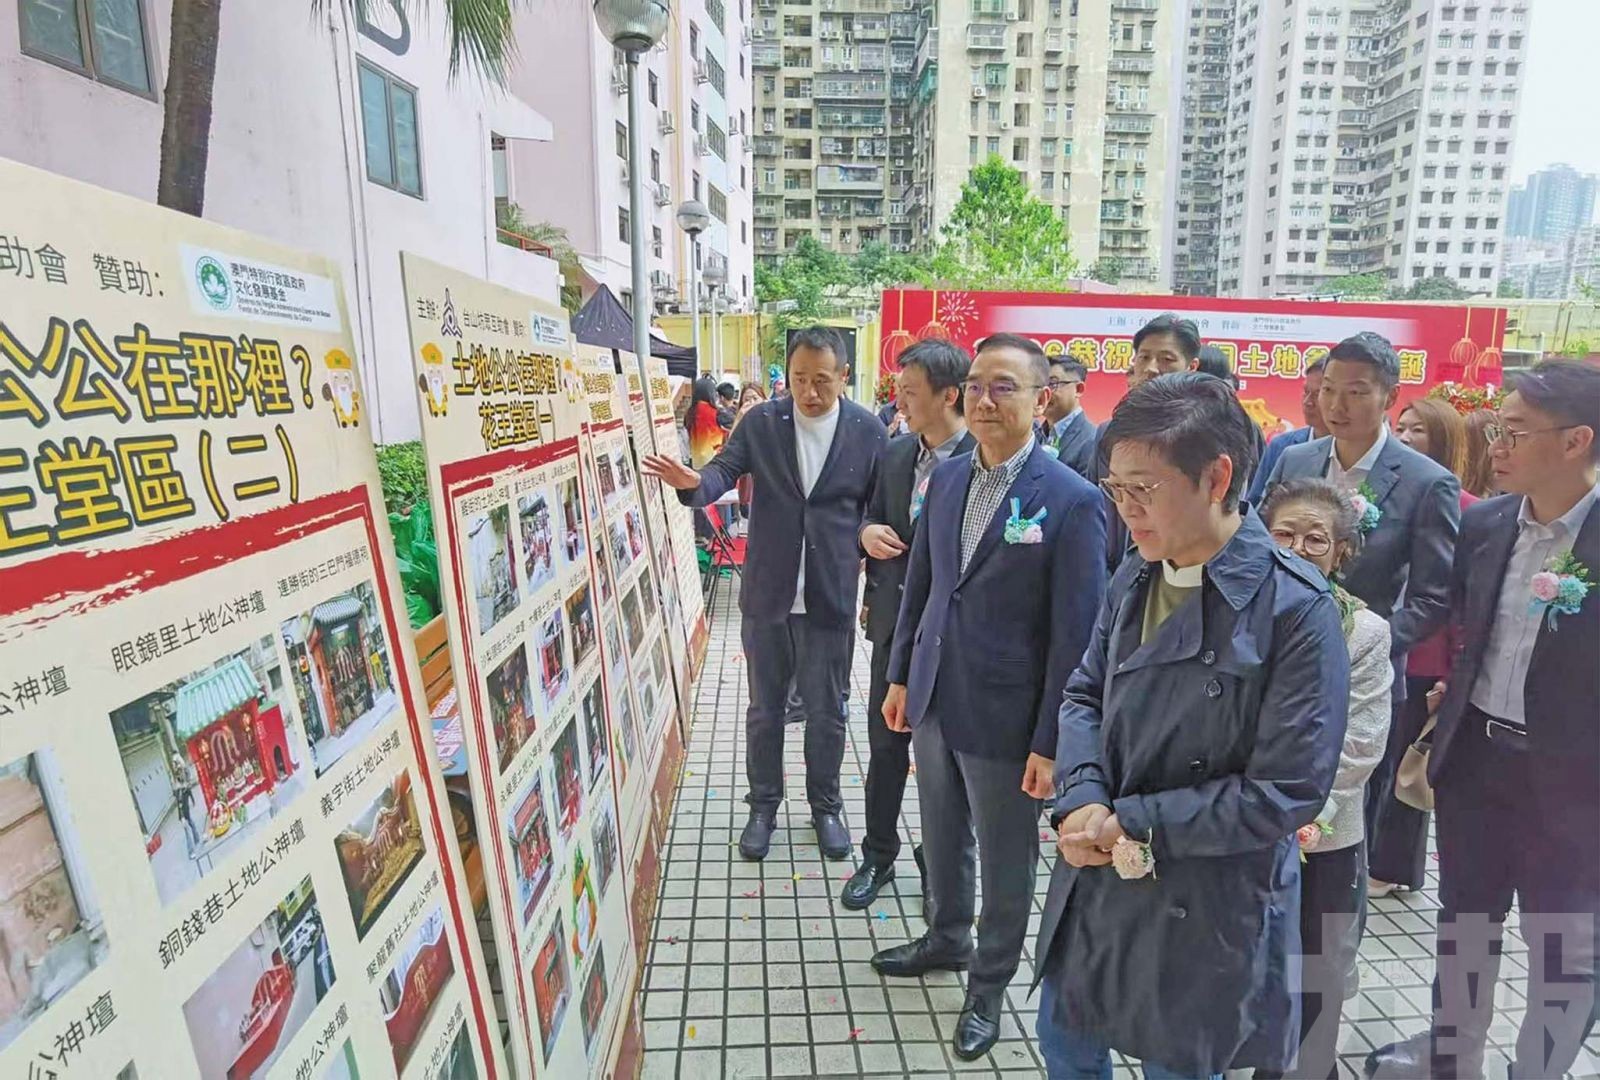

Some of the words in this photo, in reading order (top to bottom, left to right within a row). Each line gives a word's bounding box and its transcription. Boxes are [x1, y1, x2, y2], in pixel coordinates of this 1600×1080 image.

[452, 340, 563, 396] 土地公公在那裡?
[111, 588, 267, 674] 眼鏡里土地公神壇
[320, 729, 402, 819] 義字街土地公神壇
[158, 817, 306, 970] 銅錢巷土地公神壇
